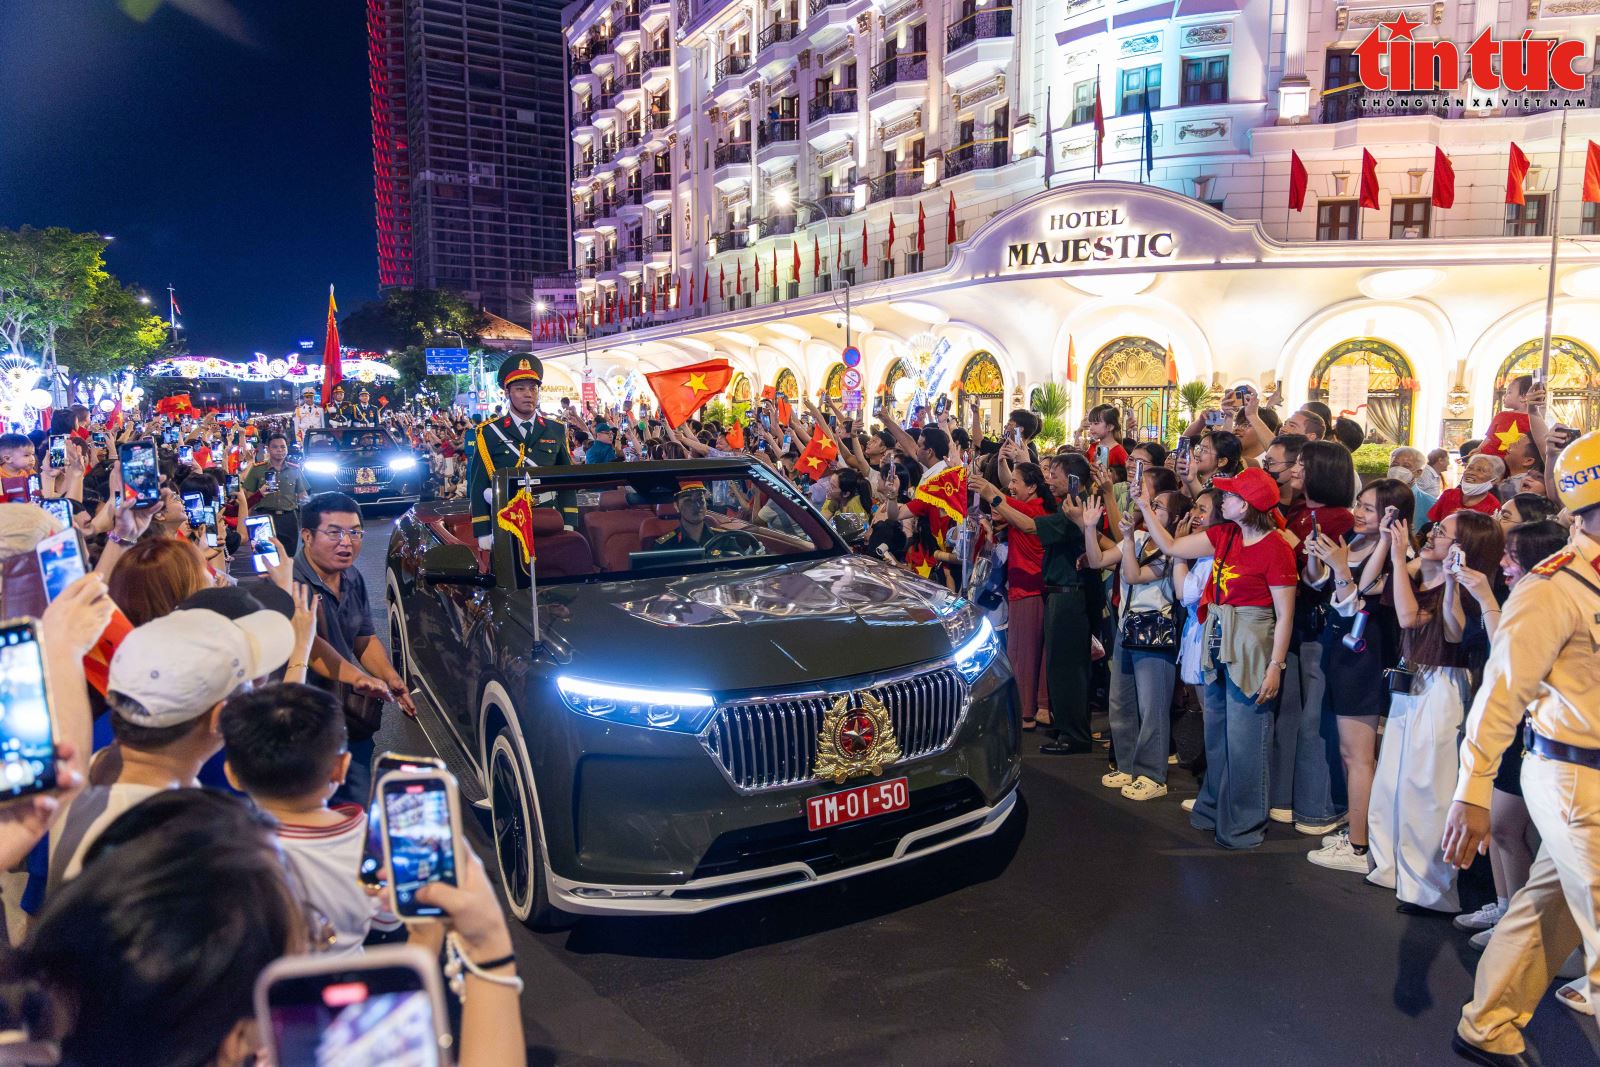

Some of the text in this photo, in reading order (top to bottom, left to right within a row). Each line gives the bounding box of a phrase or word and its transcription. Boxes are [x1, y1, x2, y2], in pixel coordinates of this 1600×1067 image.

[1050, 209, 1126, 231] HOTEL
[1008, 233, 1174, 267] MAJESTIC
[1558, 464, 1600, 493] CSGT
[811, 782, 906, 826] TM-01-50
